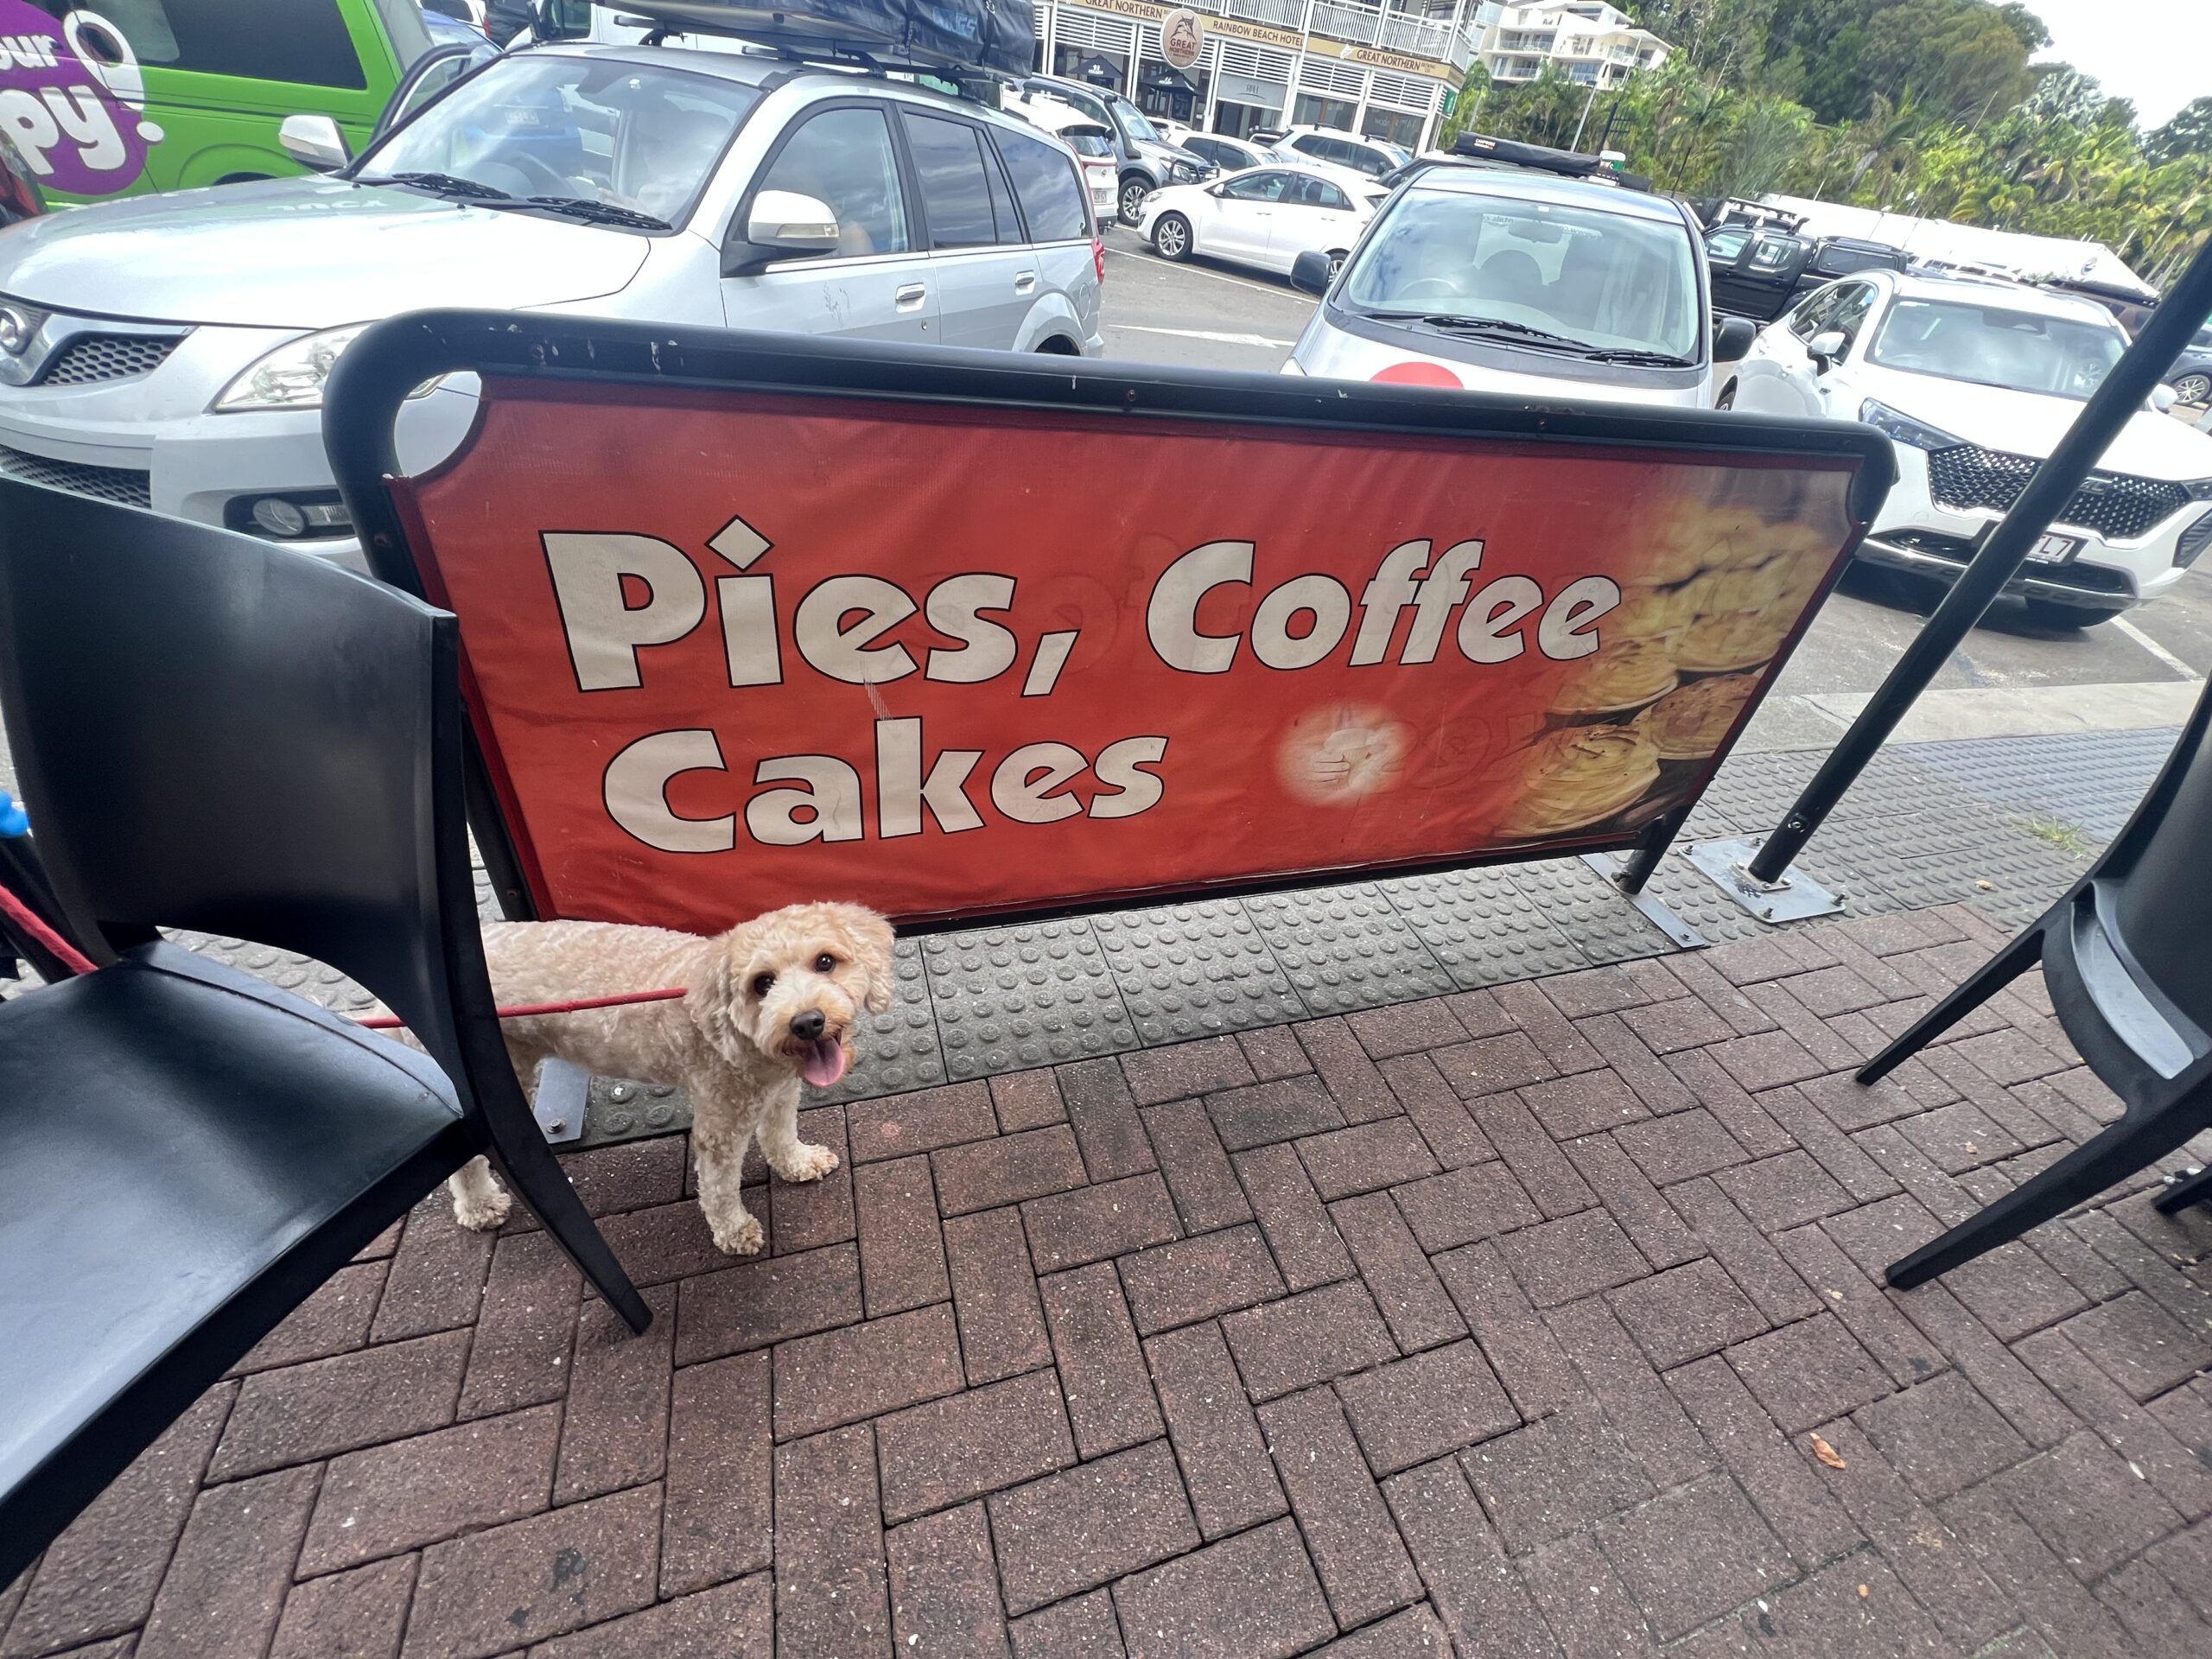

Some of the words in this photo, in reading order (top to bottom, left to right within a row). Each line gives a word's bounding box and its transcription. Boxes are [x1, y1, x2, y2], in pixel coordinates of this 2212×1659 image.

[1115, 0, 1163, 19] NORTHERN
[1170, 38, 1197, 50] GREAT
[1212, 20, 1251, 35] RAINBOW
[1252, 28, 1278, 41] BEACH
[1280, 35, 1304, 47] HOTEL
[1357, 49, 1382, 62] GREAT
[1381, 54, 1421, 71] NORTHERN
[2037, 536, 2072, 556] L7
[538, 515, 1081, 698] Pies,
[1146, 538, 1622, 674] Coffee
[602, 715, 1170, 854] Cakes
